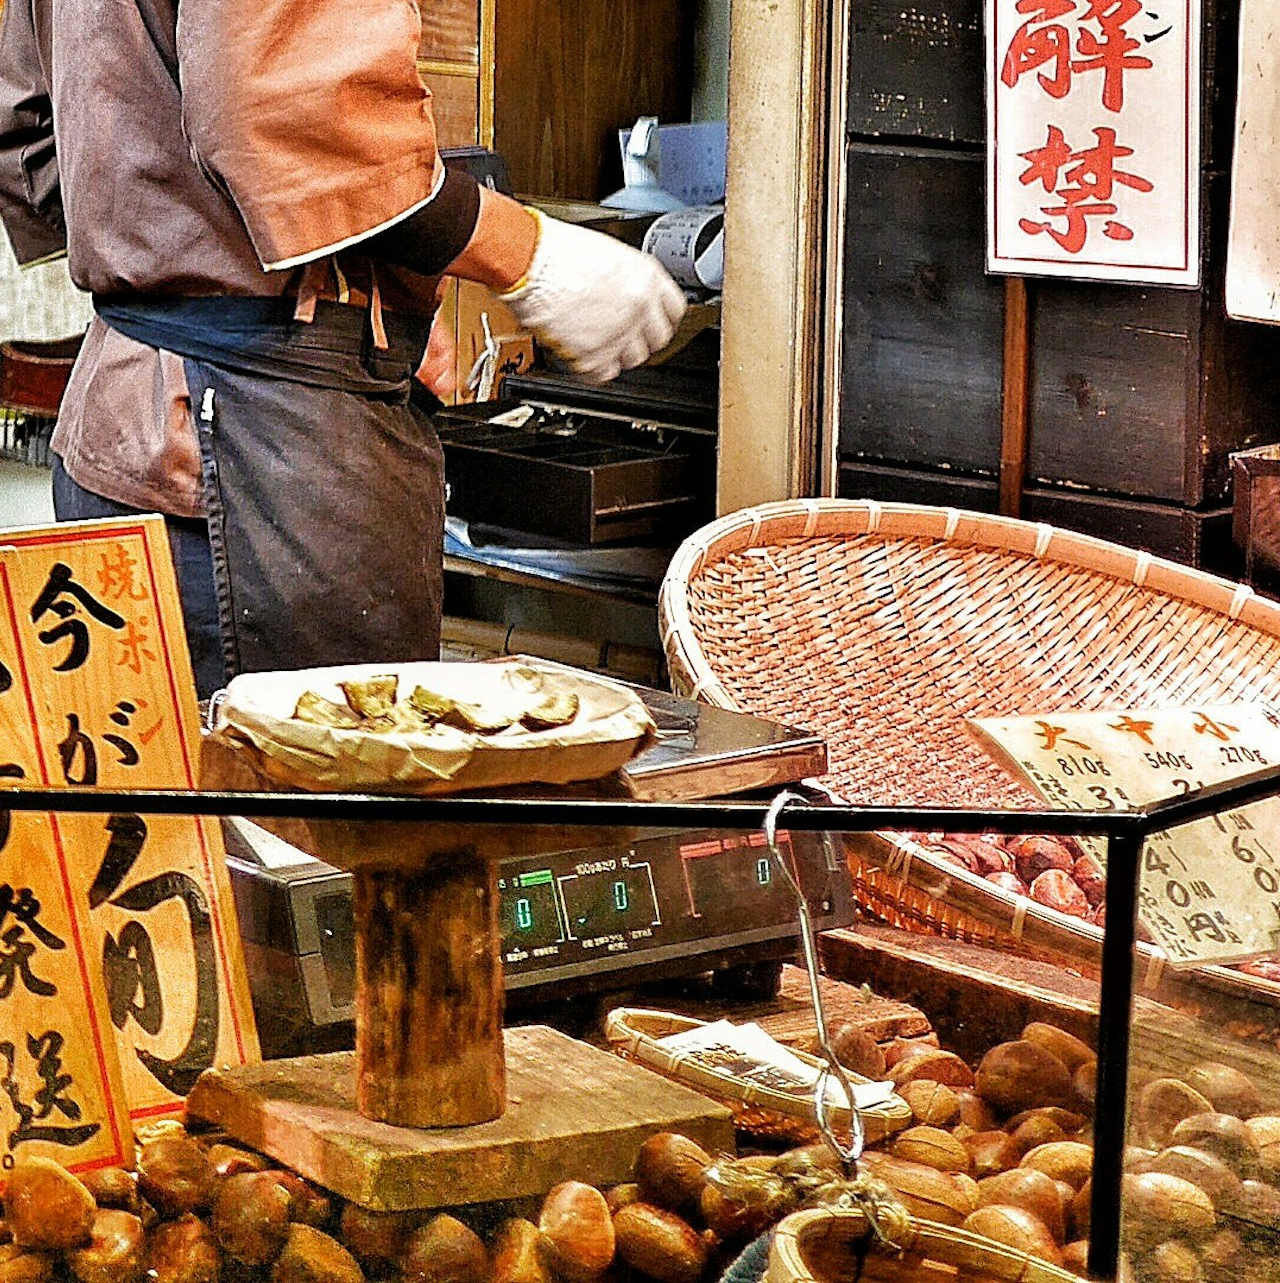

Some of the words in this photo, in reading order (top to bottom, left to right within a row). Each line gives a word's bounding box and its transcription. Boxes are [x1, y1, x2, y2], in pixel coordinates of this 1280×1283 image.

[96, 543, 167, 745] 焼ポン
[1034, 720, 1091, 750] 大
[30, 562, 218, 1097] 今が旬
[757, 859, 771, 885] 0
[614, 882, 628, 910] 0
[517, 899, 532, 928] 0
